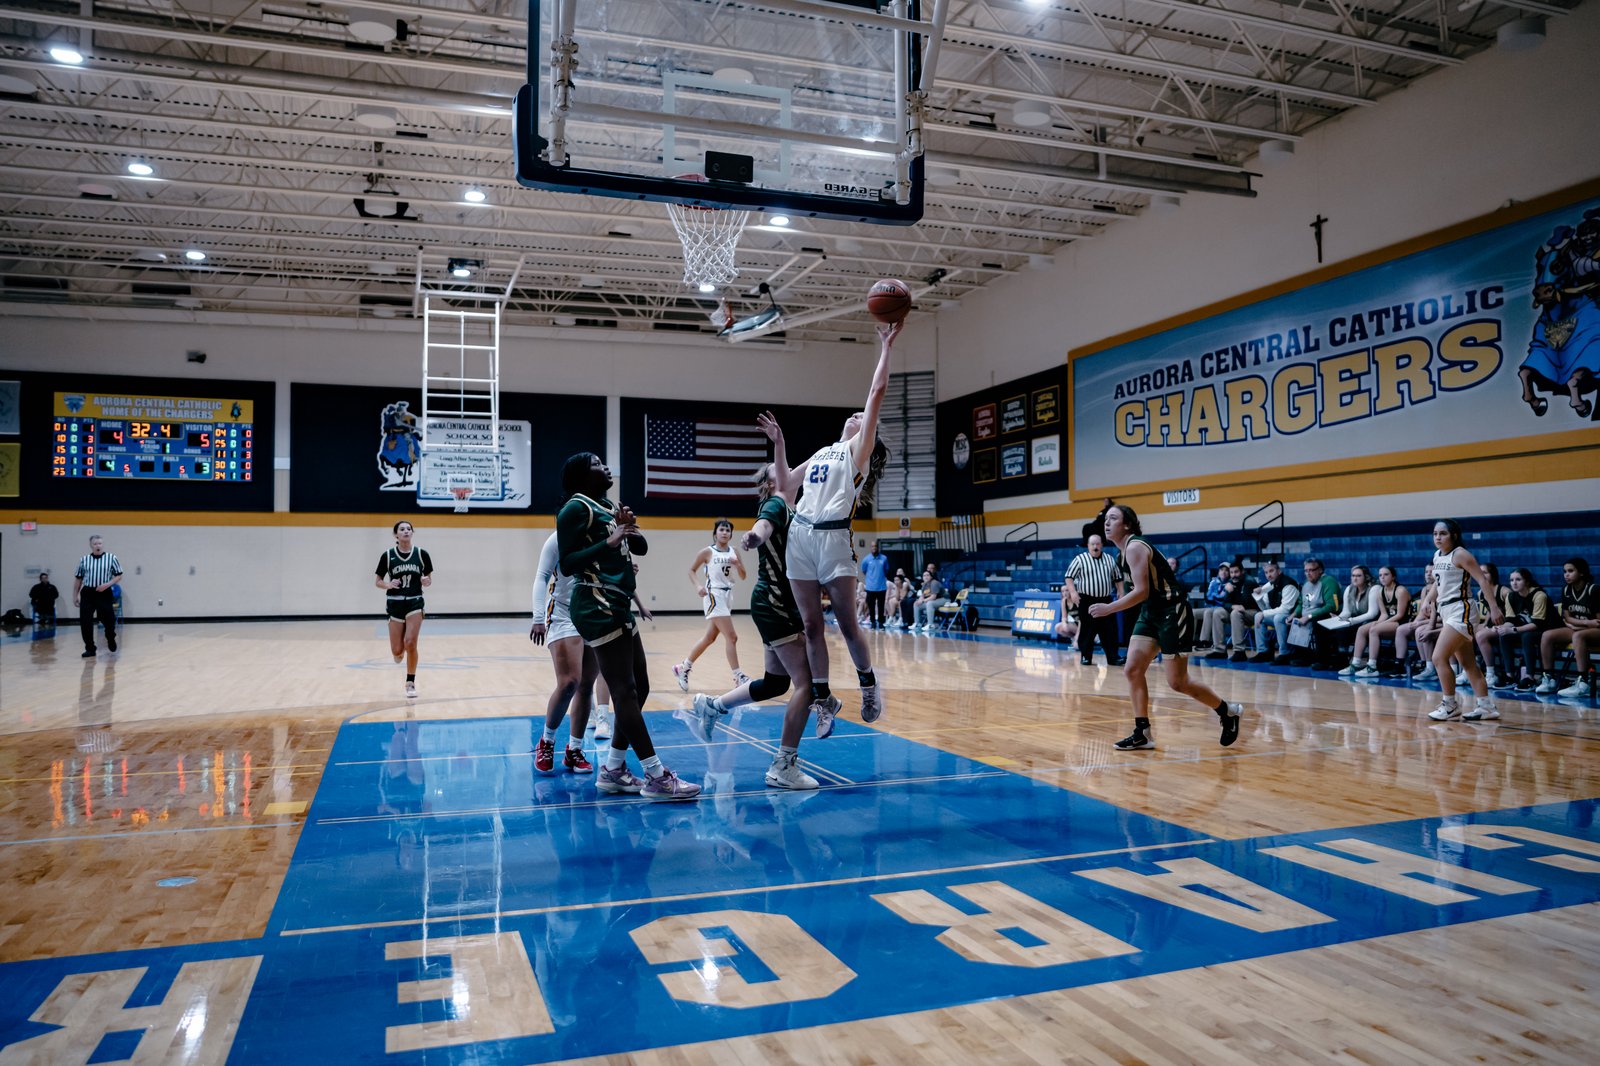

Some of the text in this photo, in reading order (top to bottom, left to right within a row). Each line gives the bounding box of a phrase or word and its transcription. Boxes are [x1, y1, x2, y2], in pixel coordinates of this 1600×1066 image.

[1114, 285, 1504, 400] AURORA CENTRAL CATHOLIC
[1114, 318, 1503, 447] CHARGERS
[94, 396, 132, 407] AURORA
[135, 398, 175, 408] CENTRAL
[178, 399, 222, 410] CATHOLIC
[102, 407, 214, 420] HOME OF THE CHARGERS
[54, 422, 94, 432] 01 0 1
[447, 422, 467, 430] CENTRAL
[468, 422, 491, 431] CATHOLIC
[504, 424, 522, 432] SCHOOL
[56, 434, 94, 443] 10 0 3
[114, 431, 123, 445] 4
[215, 428, 251, 438] 04 0 0
[200, 434, 210, 448] 5
[230, 440, 237, 448] 0
[246, 440, 251, 448] 0
[56, 446, 94, 455] 15 0 0
[166, 442, 170, 454] 1
[218, 450, 226, 458] 11
[246, 451, 251, 459] 3
[54, 456, 93, 466] 20 1 0
[215, 460, 251, 470] 30 0 0
[53, 468, 66, 476] 25
[86, 468, 93, 476] 0
[106, 460, 210, 474] 4 5 5 3
[215, 472, 226, 480] 34
[245, 472, 251, 480] 0
[810, 464, 830, 484] 23
[1166, 488, 1196, 504] VISITORS
[722, 566, 732, 577] 15
[402, 574, 412, 589] 11
